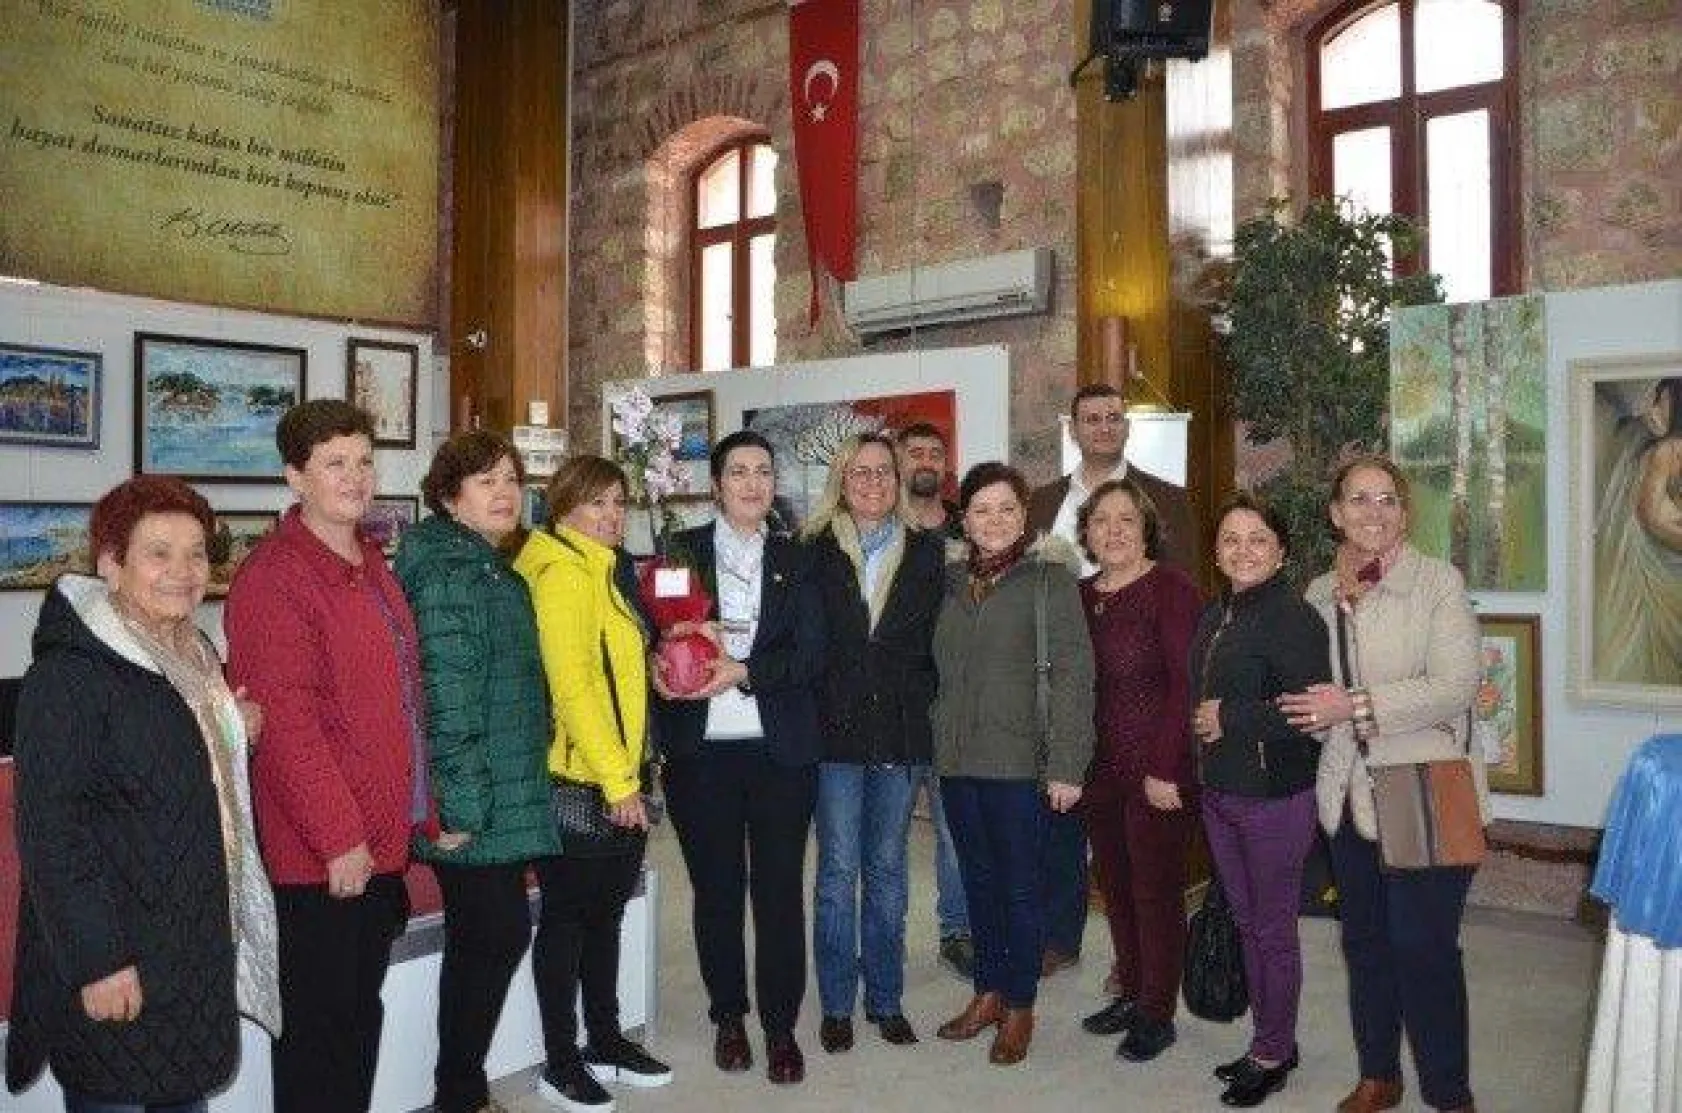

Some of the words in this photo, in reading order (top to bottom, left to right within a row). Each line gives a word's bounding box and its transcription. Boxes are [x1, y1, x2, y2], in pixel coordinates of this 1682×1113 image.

[11, 115, 74, 150] hayat
[186, 122, 241, 151] kalan
[247, 136, 274, 156] bir
[278, 149, 346, 172] milletin
